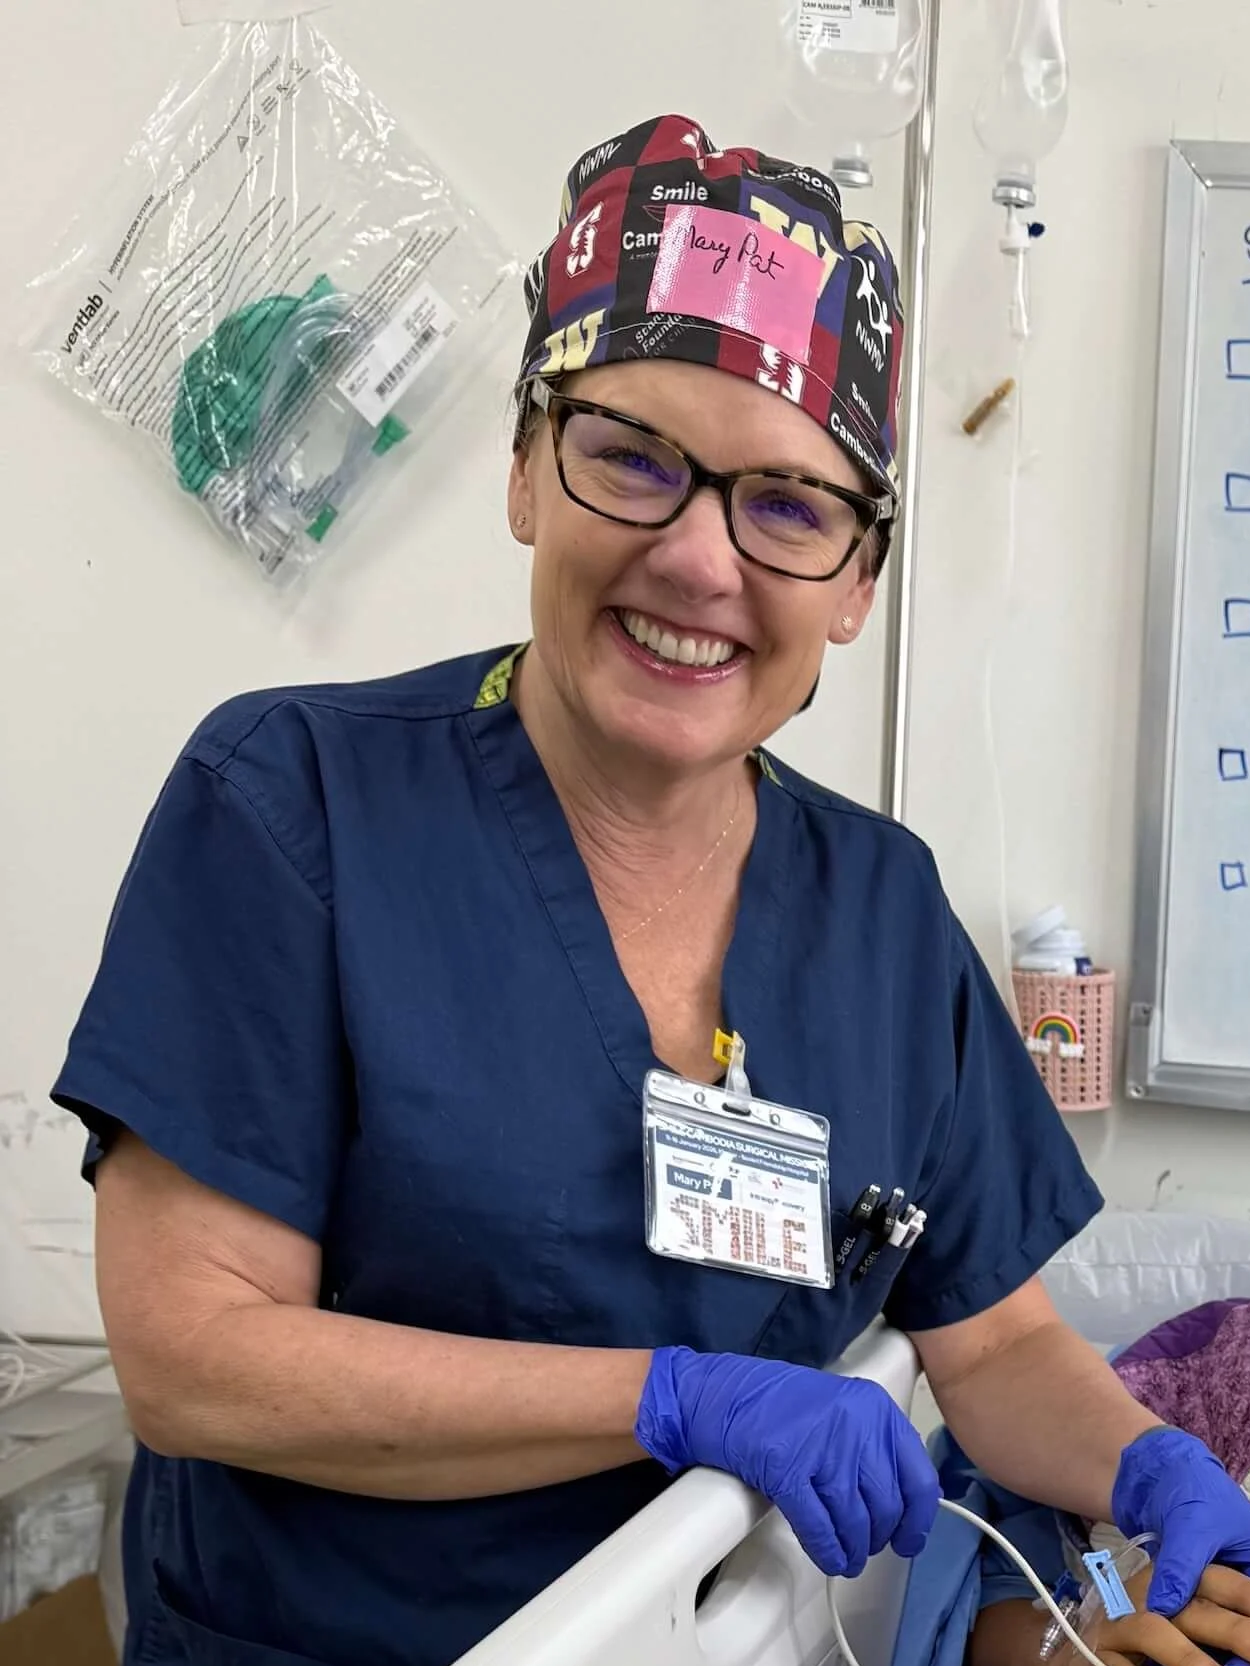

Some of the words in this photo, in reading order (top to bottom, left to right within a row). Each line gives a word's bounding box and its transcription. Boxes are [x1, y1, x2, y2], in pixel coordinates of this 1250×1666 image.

[650, 181, 709, 201] Smile
[738, 232, 785, 281] Pat
[60, 293, 104, 355] ventlab
[673, 1171, 700, 1190] Mary
